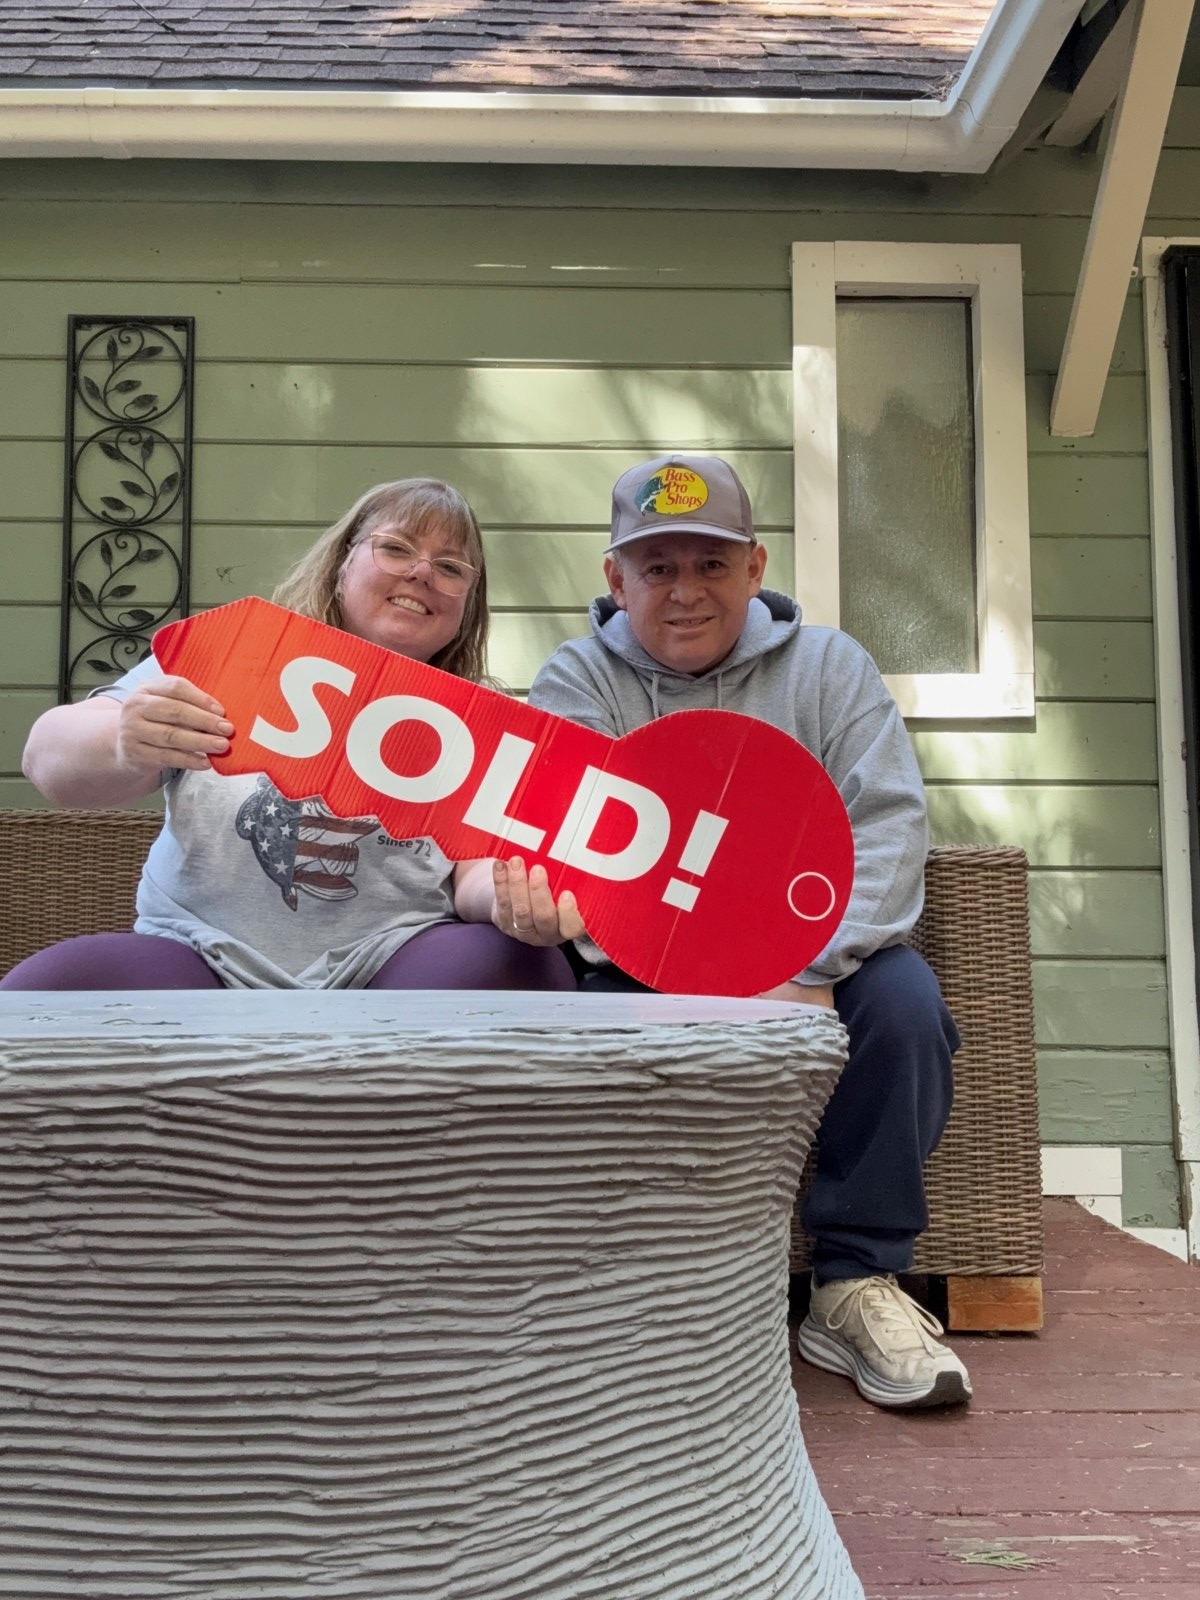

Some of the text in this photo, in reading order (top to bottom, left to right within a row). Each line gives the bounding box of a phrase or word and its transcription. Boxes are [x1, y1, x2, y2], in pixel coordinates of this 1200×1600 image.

[665, 468, 695, 482] Bass
[666, 481, 688, 493] Pro
[666, 493, 703, 508] Shops
[249, 656, 730, 912] SOLD!
[377, 835, 413, 848] Since
